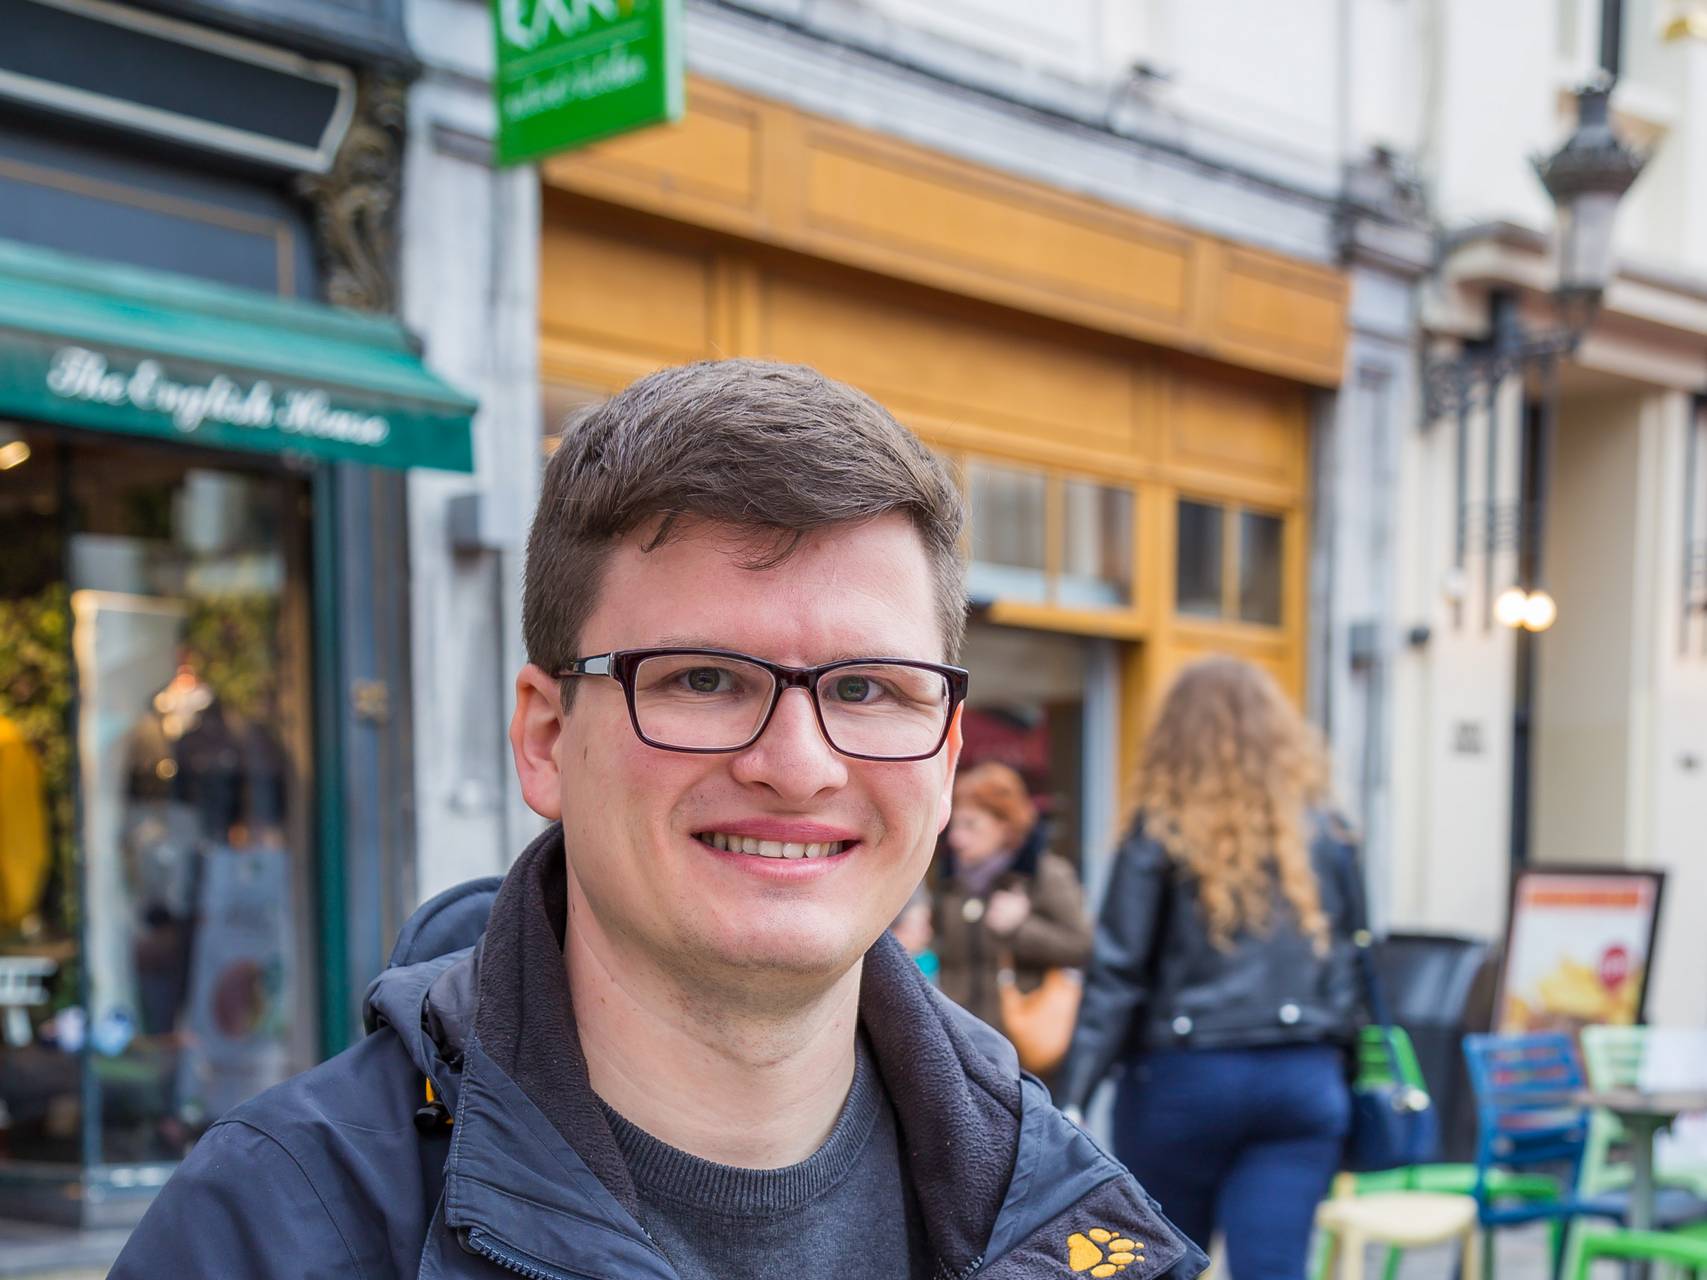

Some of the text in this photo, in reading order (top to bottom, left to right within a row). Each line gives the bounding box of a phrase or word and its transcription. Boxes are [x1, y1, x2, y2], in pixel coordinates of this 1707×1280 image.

[48, 347, 389, 446] The English Home
